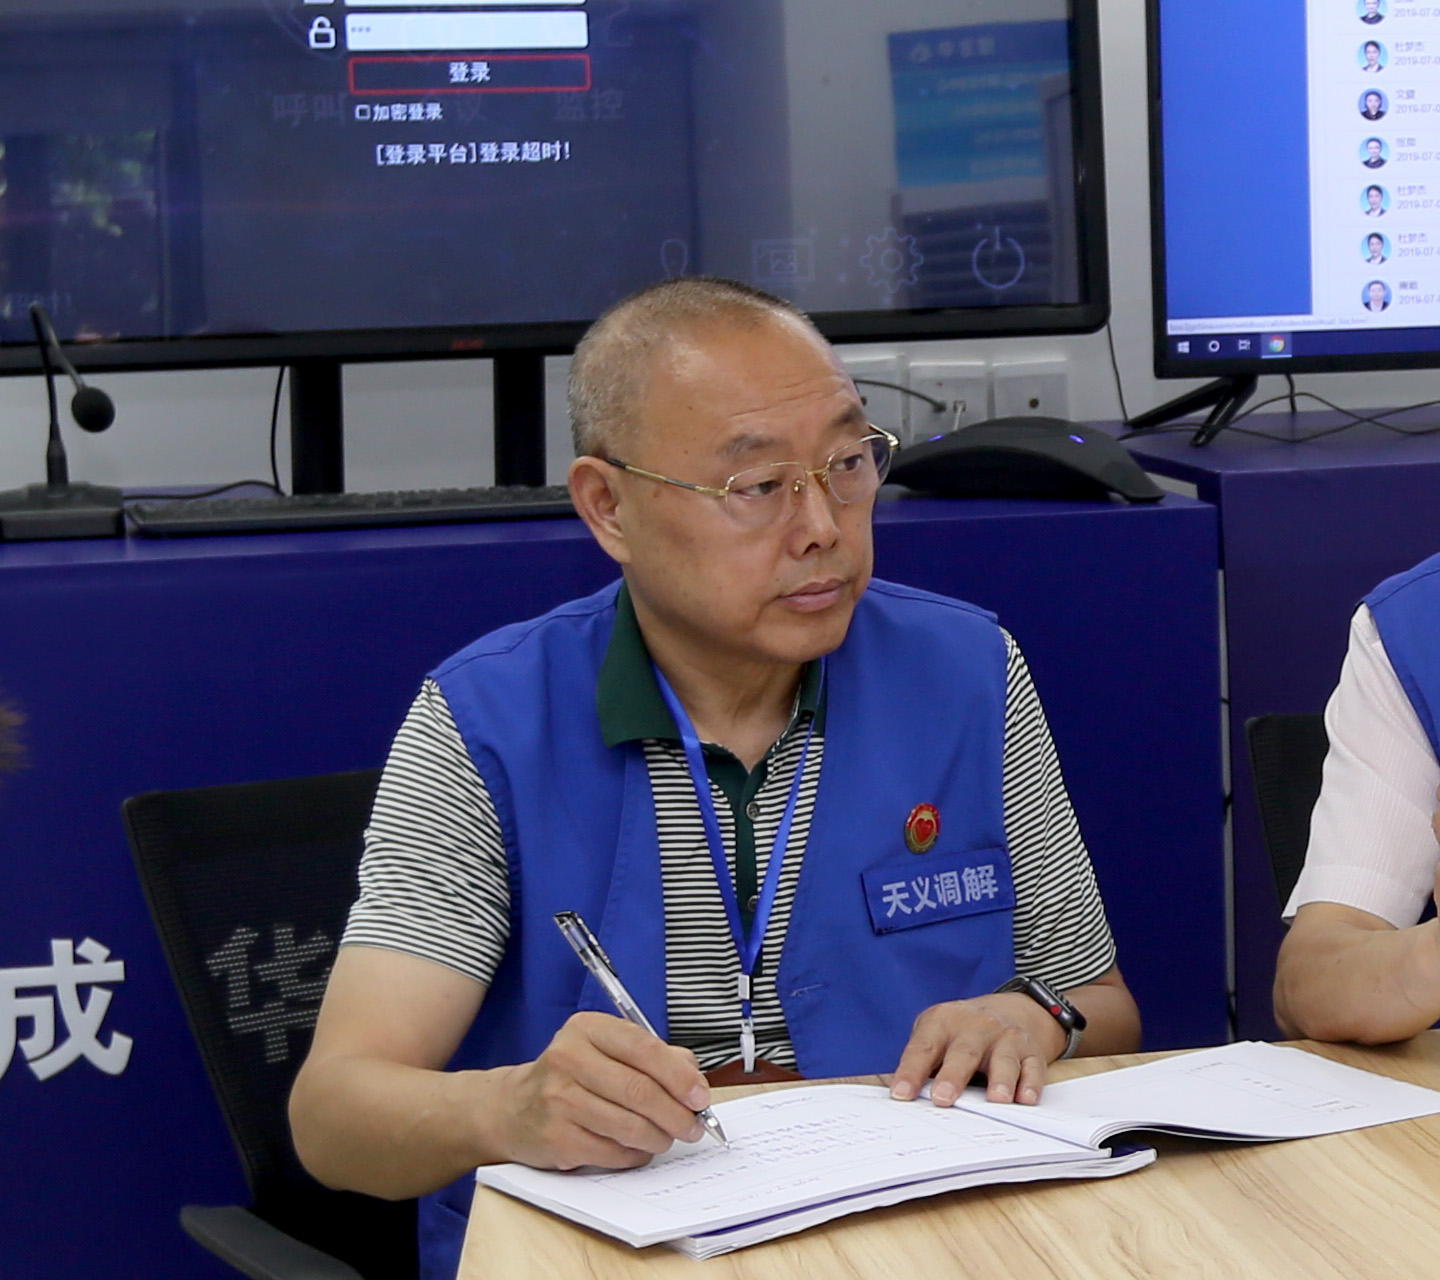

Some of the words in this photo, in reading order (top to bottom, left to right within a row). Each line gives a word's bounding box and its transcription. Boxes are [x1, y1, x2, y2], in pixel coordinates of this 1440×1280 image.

[449, 61, 491, 83] 登录
[372, 103, 444, 121] 加密登录
[882, 864, 999, 918] 天义调解
